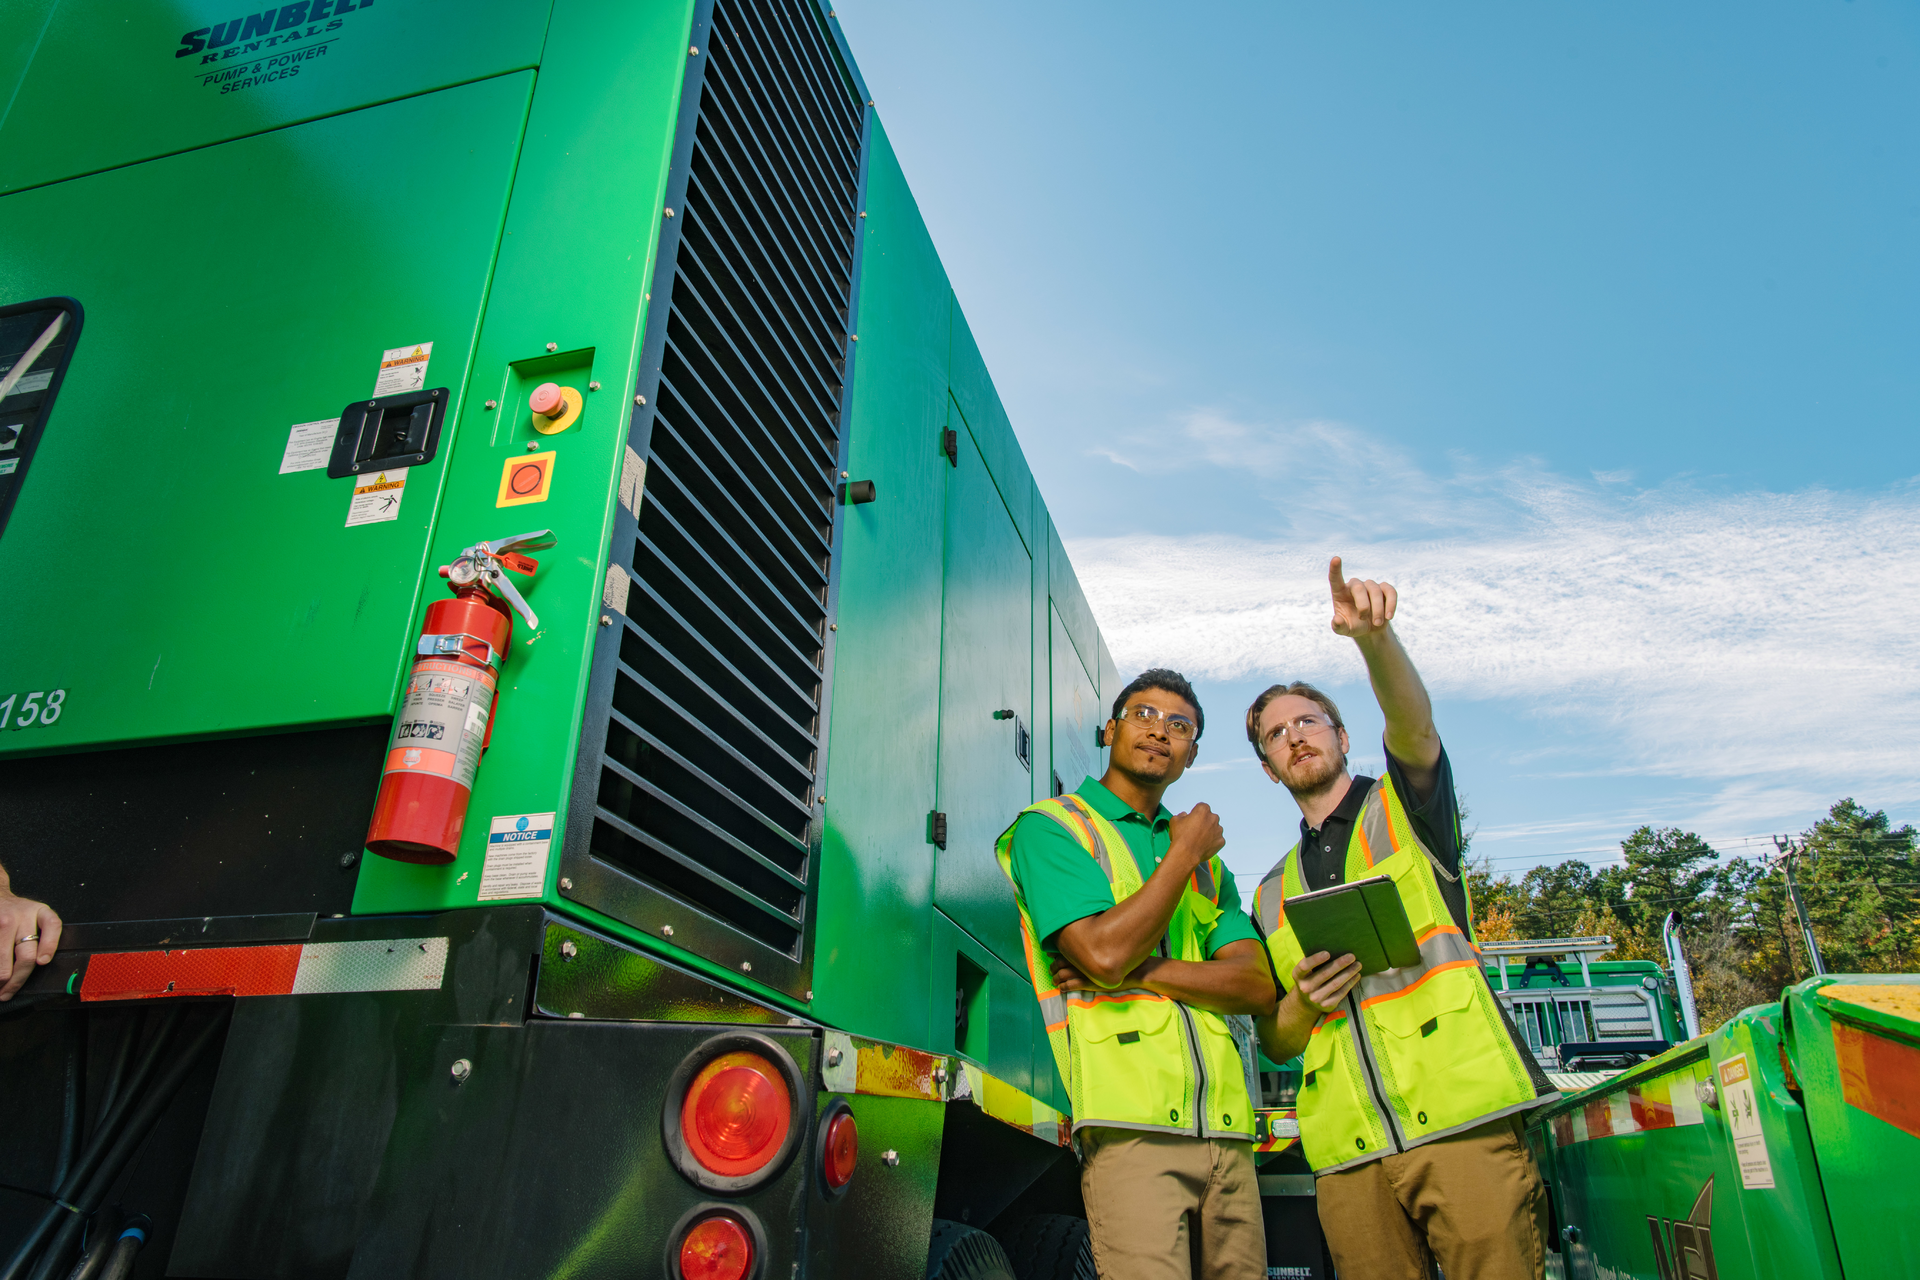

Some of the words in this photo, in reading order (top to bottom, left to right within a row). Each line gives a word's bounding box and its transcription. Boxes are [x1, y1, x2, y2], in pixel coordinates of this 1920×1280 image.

[199, 18, 344, 66] RENTALS
[202, 66, 248, 86] PUMP
[252, 62, 262, 74] &
[267, 45, 328, 70] POWER
[220, 64, 300, 95] SERVICES
[394, 356, 424, 366] WARNING
[368, 482, 400, 492] WARNING
[503, 831, 538, 842] NOTICE
[1727, 1062, 1745, 1081] DANGER
